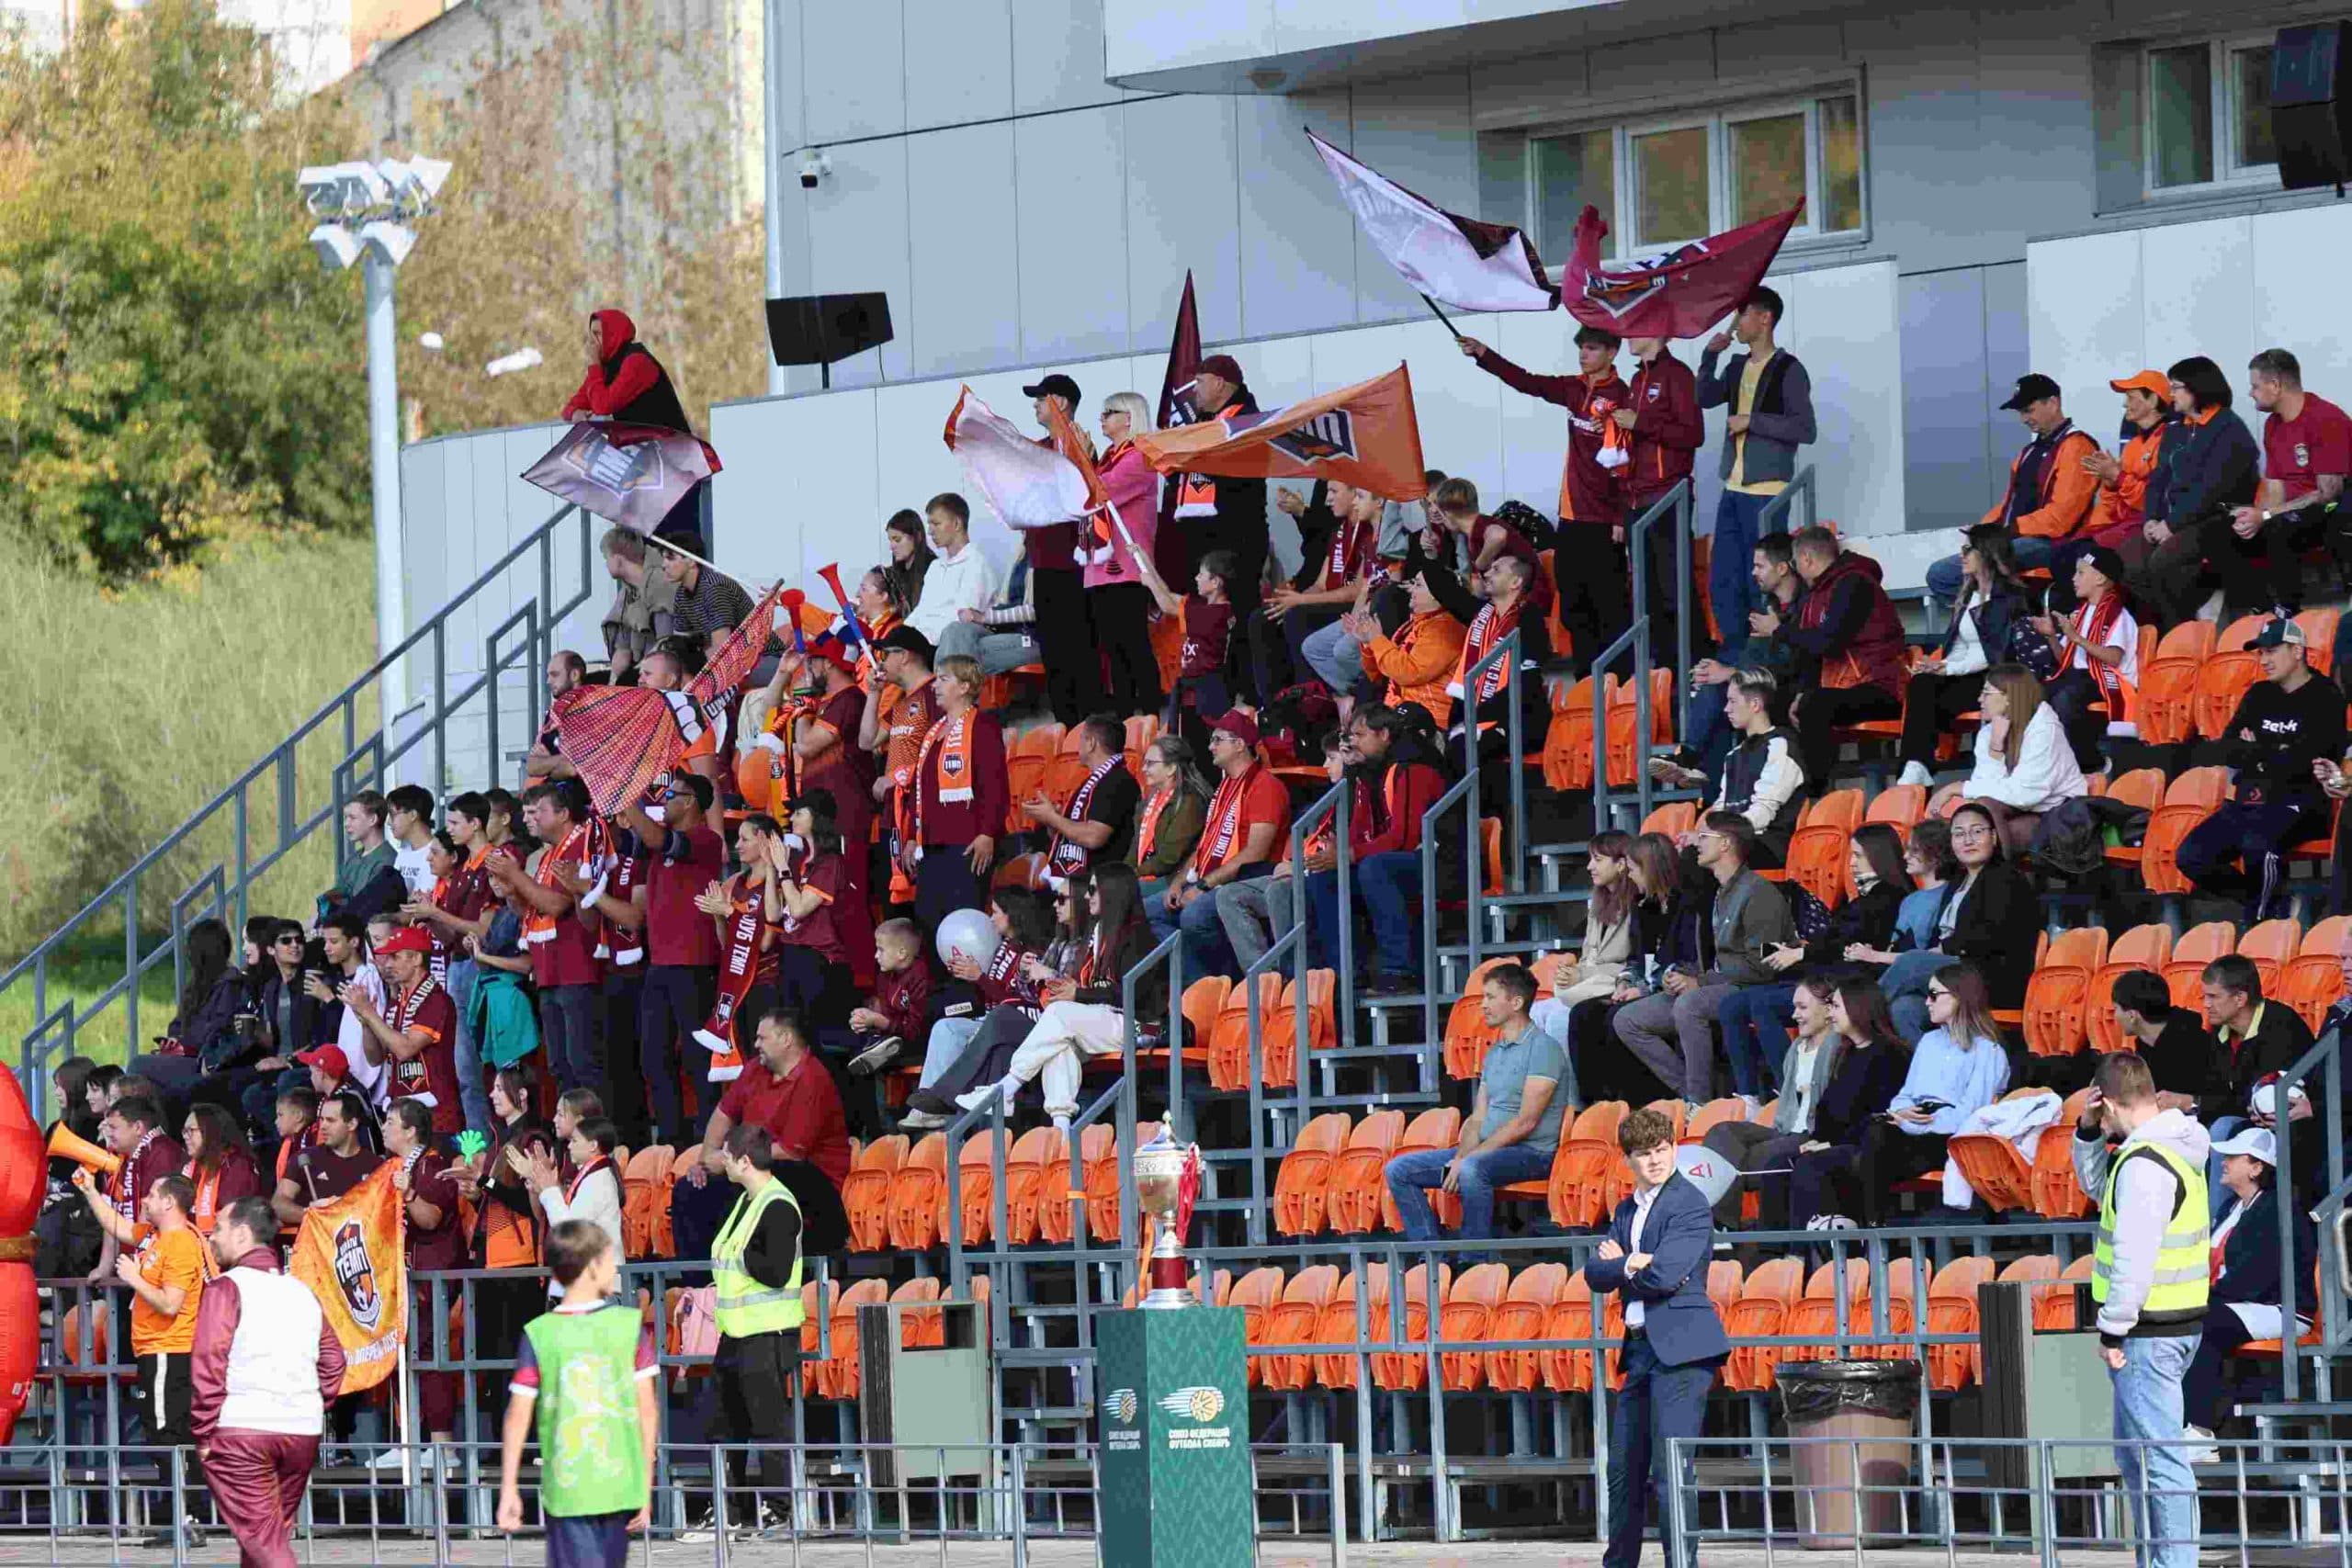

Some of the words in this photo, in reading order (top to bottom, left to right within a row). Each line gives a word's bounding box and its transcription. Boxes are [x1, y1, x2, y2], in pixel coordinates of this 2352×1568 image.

[1059, 844, 1082, 862] ТЕМП
[736, 915, 757, 942] ЛУБ
[729, 943, 751, 976] ТЕМП
[400, 1061, 424, 1080] ТЕМП
[336, 1247, 368, 1283] ТЕМП
